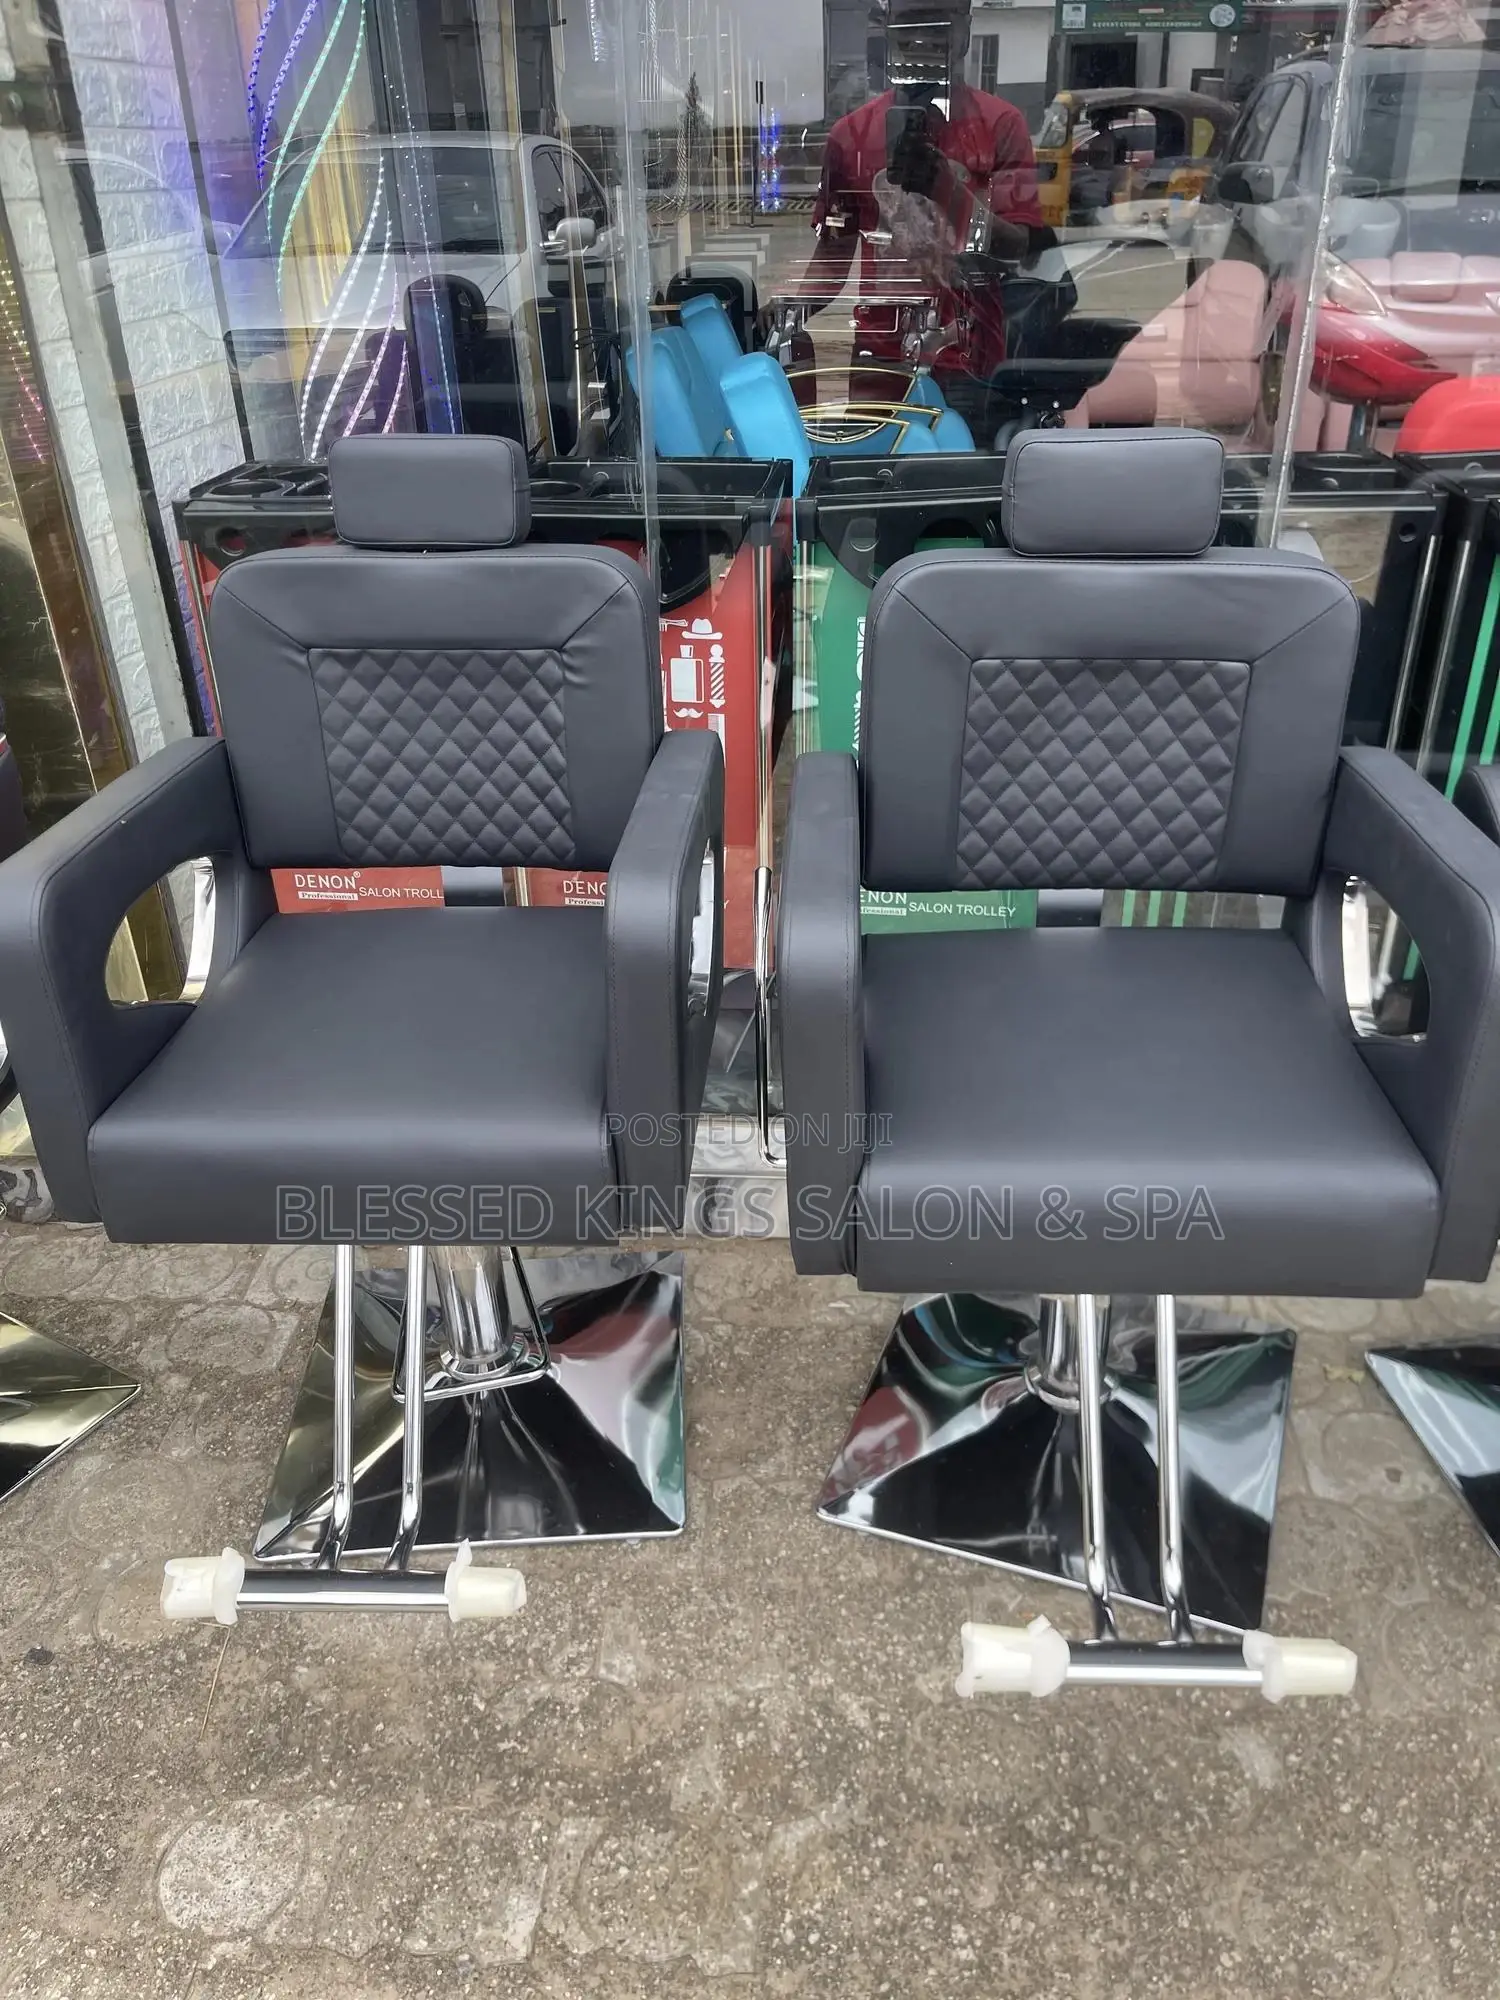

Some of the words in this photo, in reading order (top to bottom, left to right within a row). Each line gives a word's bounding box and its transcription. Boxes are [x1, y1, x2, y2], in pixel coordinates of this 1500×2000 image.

[301, 892, 356, 900] Professional
[359, 886, 401, 898] SALON
[908, 901, 953, 914] SALON
[956, 903, 1017, 918] TROLLEY
